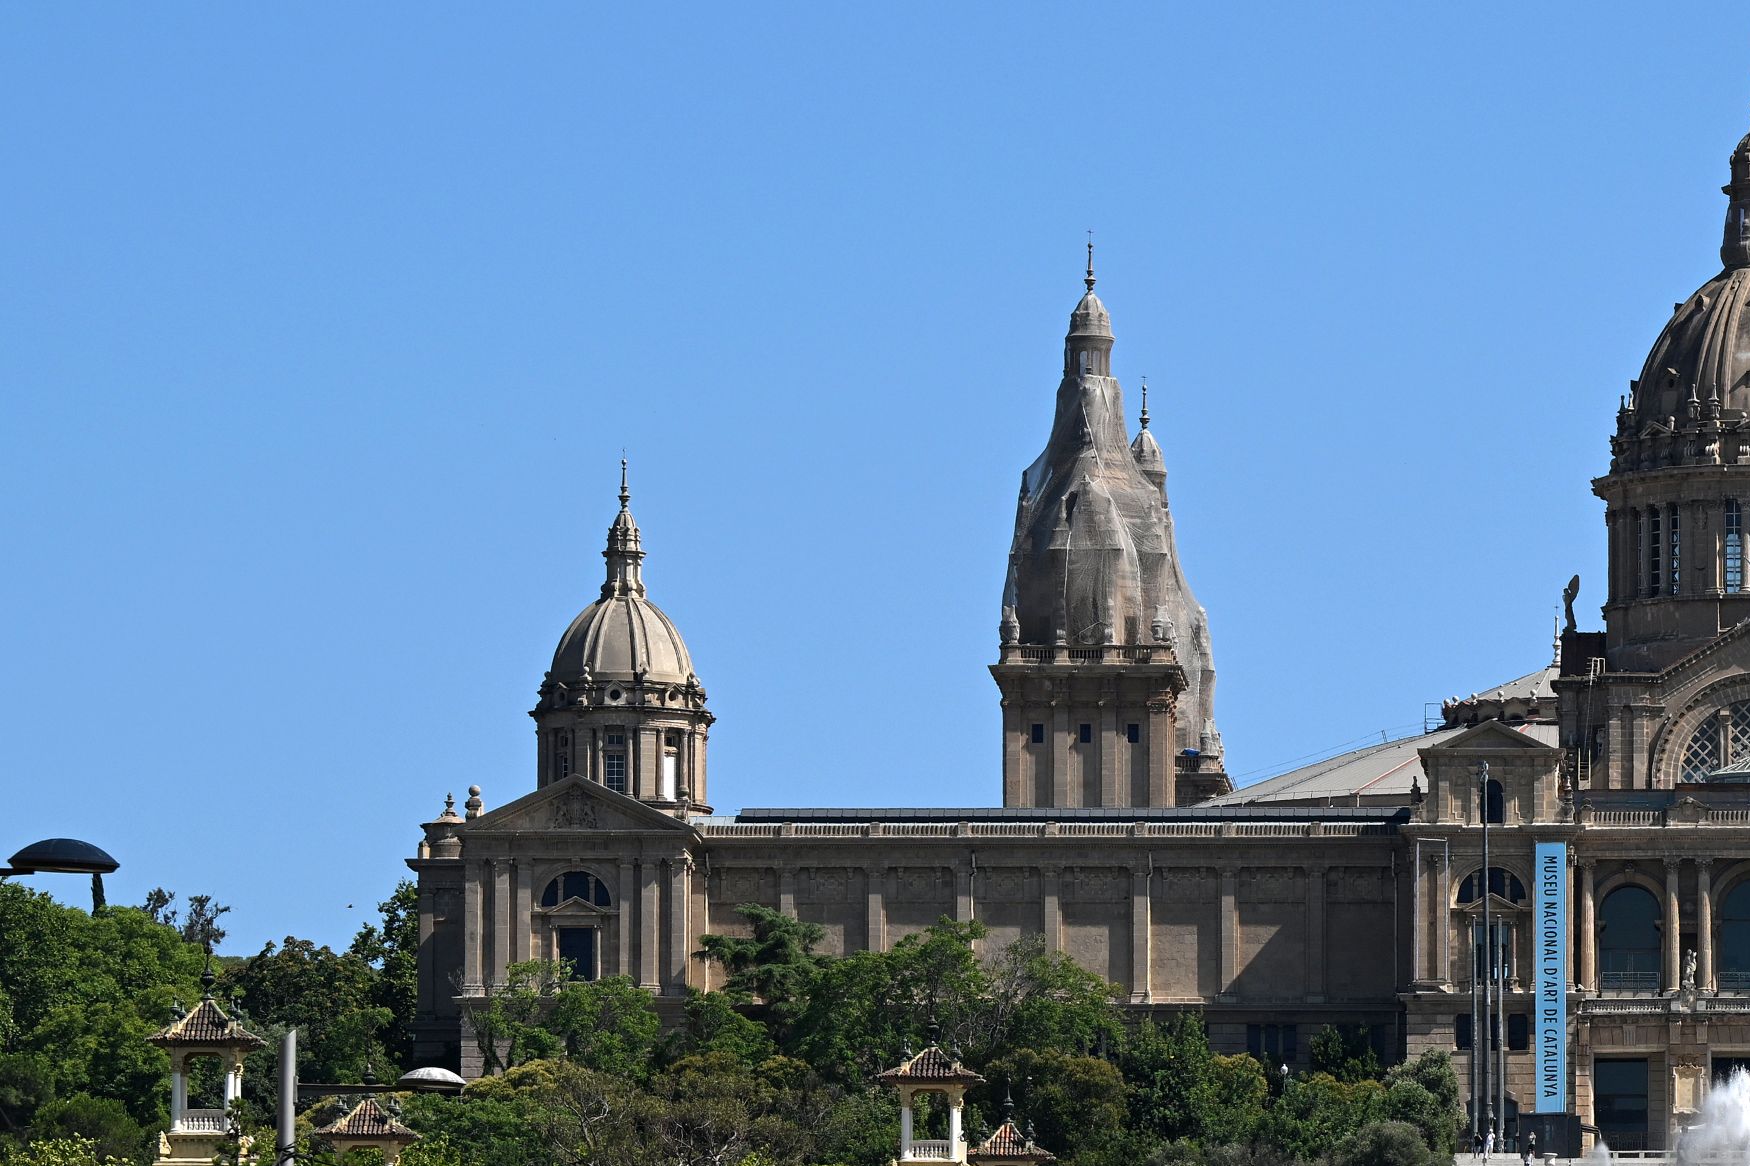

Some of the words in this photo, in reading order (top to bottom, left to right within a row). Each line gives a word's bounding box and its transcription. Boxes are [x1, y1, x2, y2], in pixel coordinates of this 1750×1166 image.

[1543, 855, 1558, 897] MUSEU
[1543, 902, 1558, 963] NACIONAL
[1543, 968, 1558, 1004] D'ART
[1543, 1008, 1558, 1024] DE
[1543, 1029, 1558, 1099] CATALUNYA
